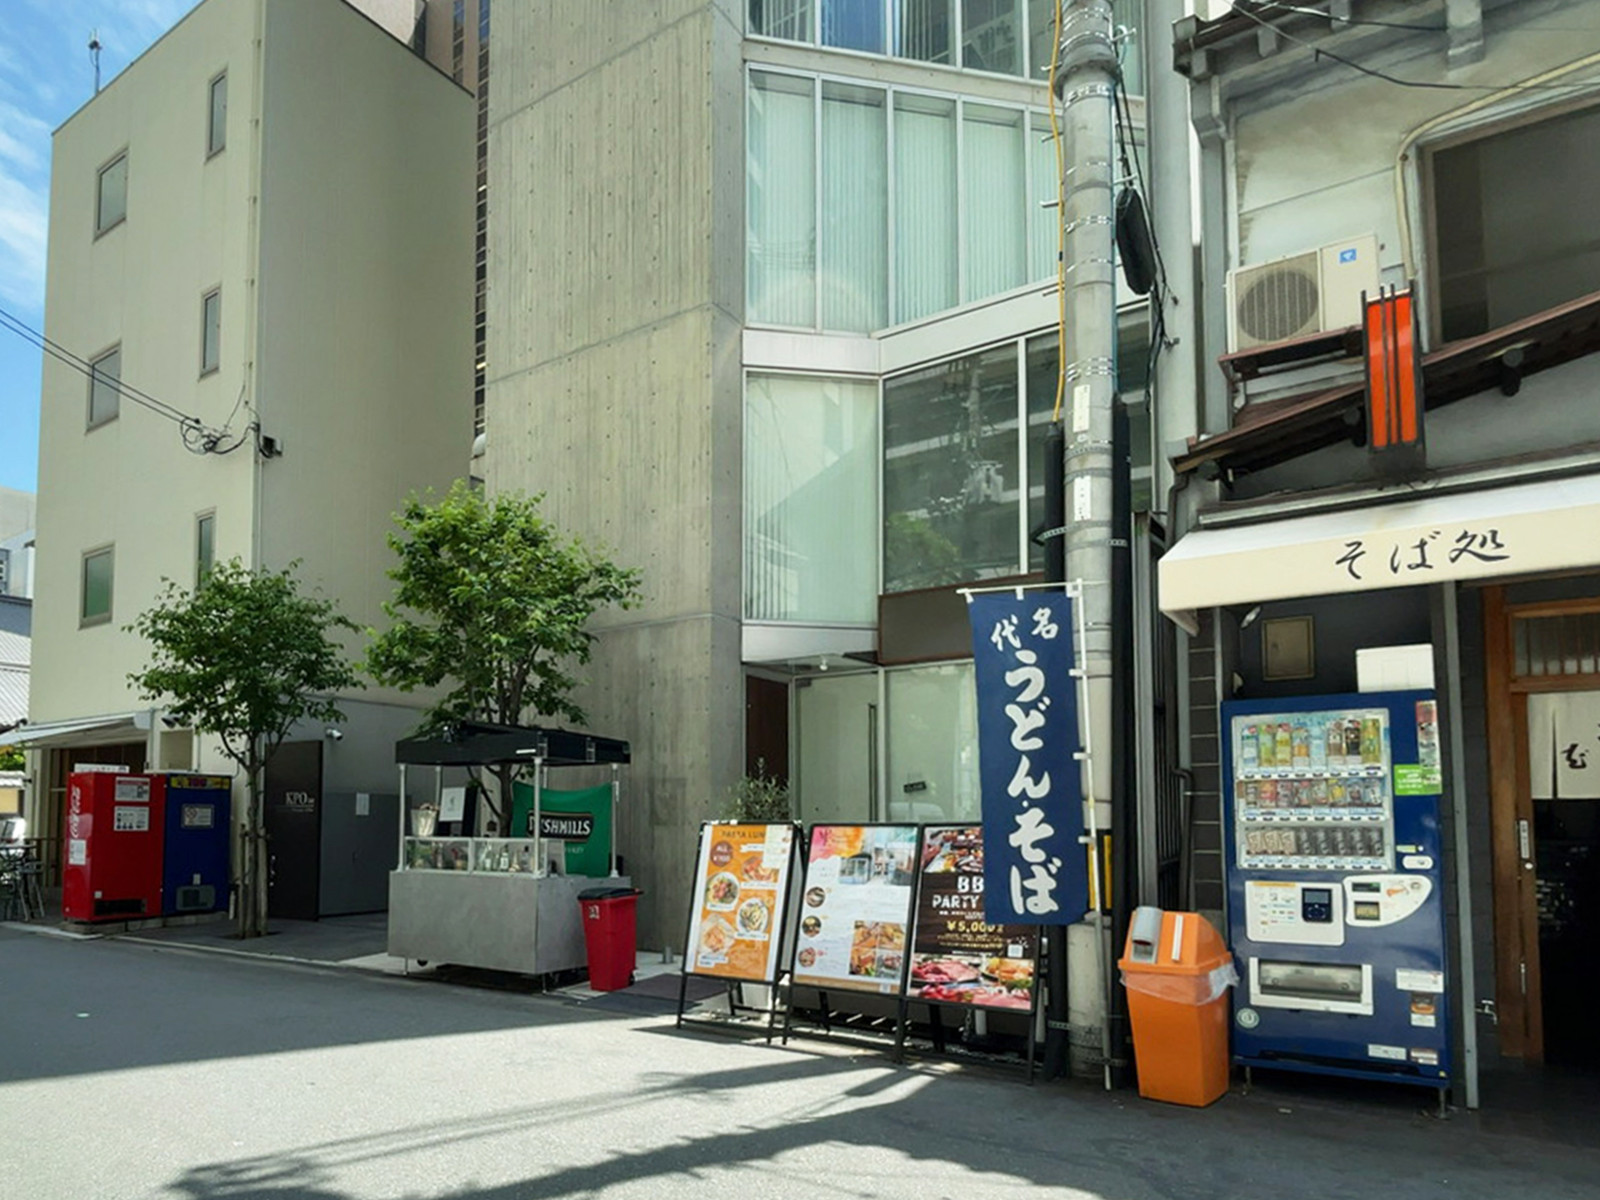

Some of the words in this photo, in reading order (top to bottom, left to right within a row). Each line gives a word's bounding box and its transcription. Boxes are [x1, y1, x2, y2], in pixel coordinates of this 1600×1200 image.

[1335, 529, 1510, 579] そば処
[931, 895, 979, 909] PARTY
